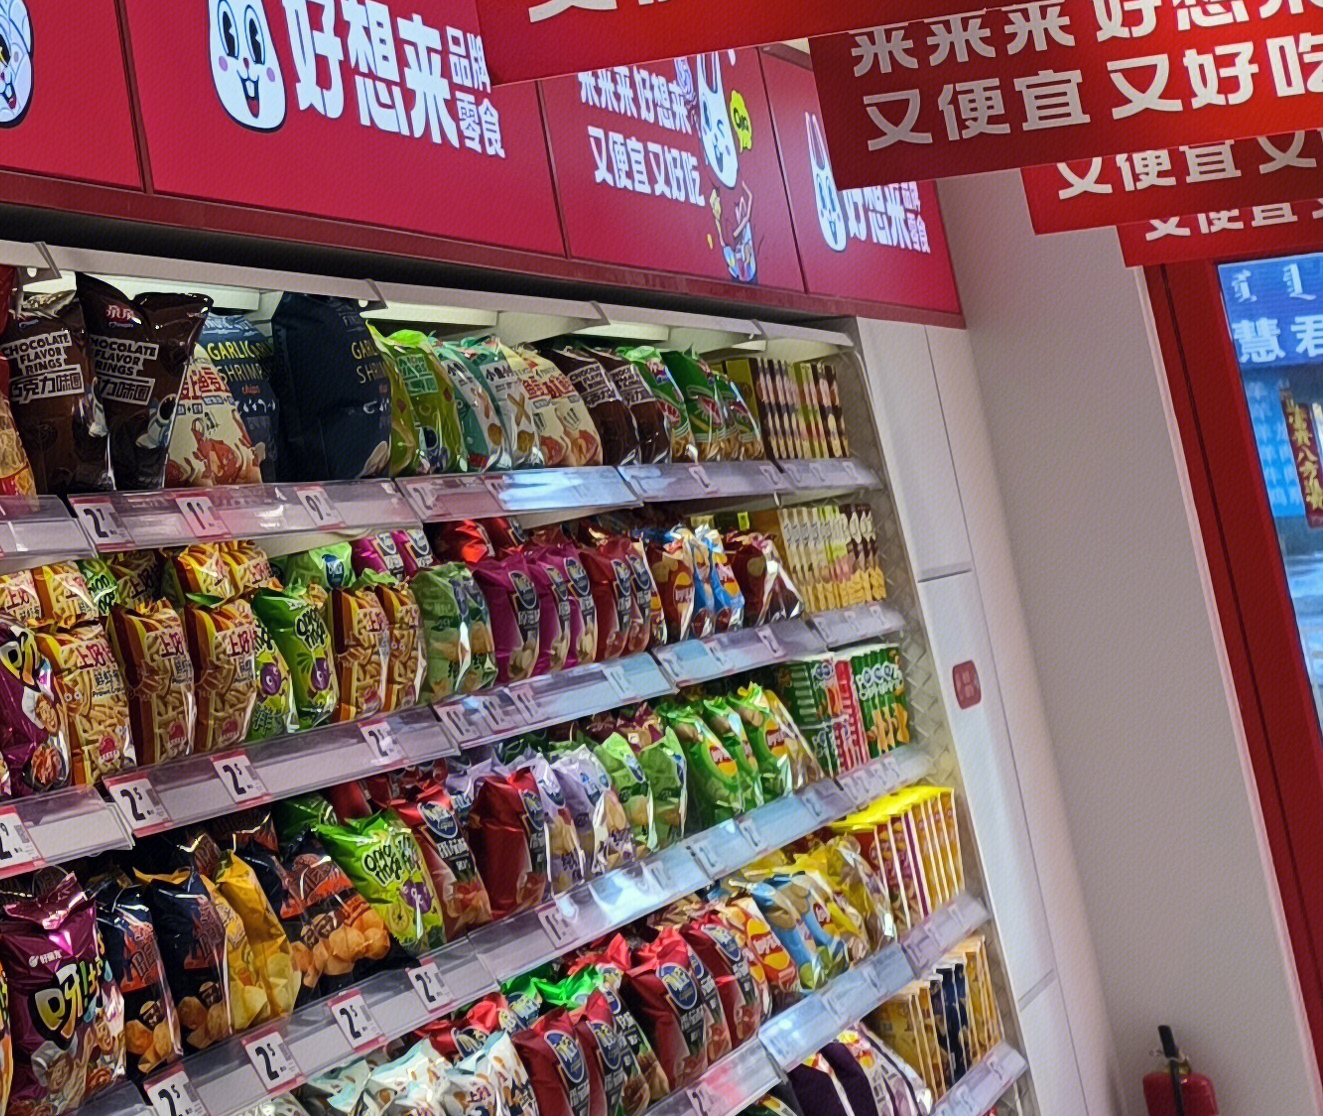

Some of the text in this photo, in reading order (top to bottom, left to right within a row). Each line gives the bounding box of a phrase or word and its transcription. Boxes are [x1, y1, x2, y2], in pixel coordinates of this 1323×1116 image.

[446, 25, 492, 94] 品牌
[863, 32, 1323, 151] 又便宜 又好吃
[455, 91, 506, 159] 零食
[588, 125, 706, 207] 又便宜 又好吃
[1057, 139, 1242, 200] 又便宜
[2, 334, 71, 357] CHOCOLATE
[20, 347, 63, 364] FLAVOR
[208, 341, 255, 361] GARLIC
[25, 358, 62, 375] RINGS
[95, 350, 141, 367] FLAVOR
[95, 361, 134, 376] RINGS
